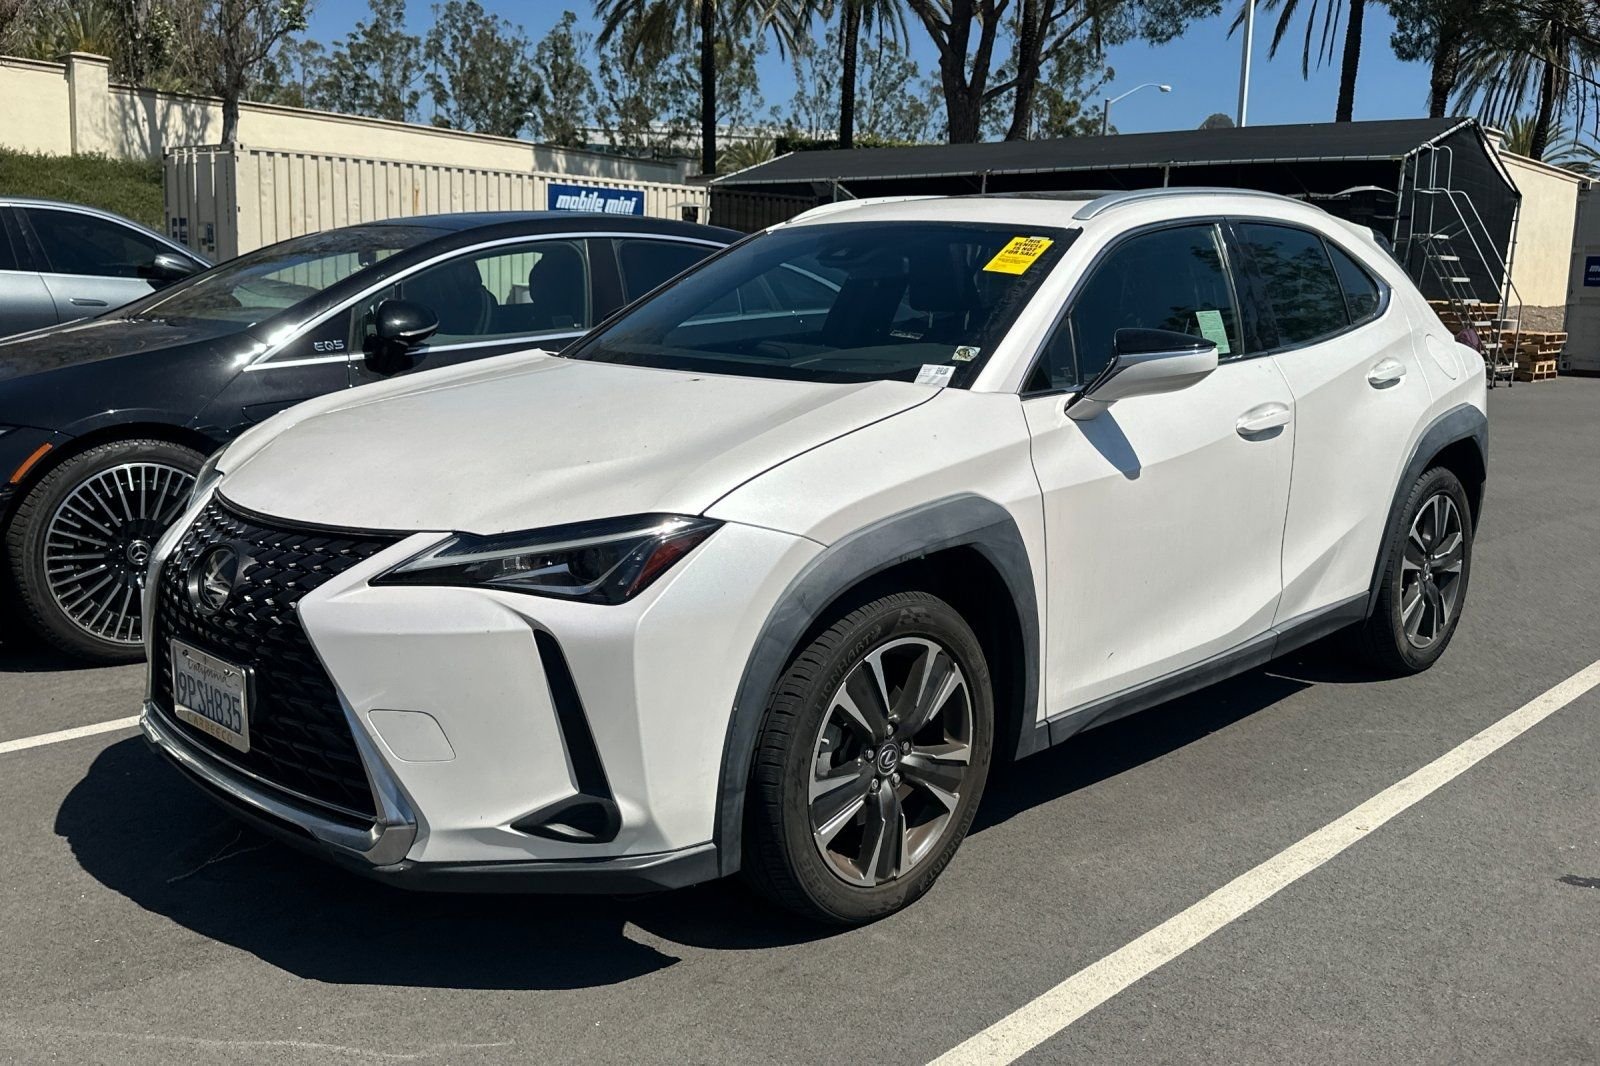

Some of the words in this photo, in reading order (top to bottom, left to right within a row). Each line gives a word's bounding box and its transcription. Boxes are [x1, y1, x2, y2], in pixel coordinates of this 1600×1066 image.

[556, 190, 604, 212] mobile
[605, 196, 637, 215] mini
[314, 339, 344, 351] EQS
[177, 671, 242, 732] 9PSH835
